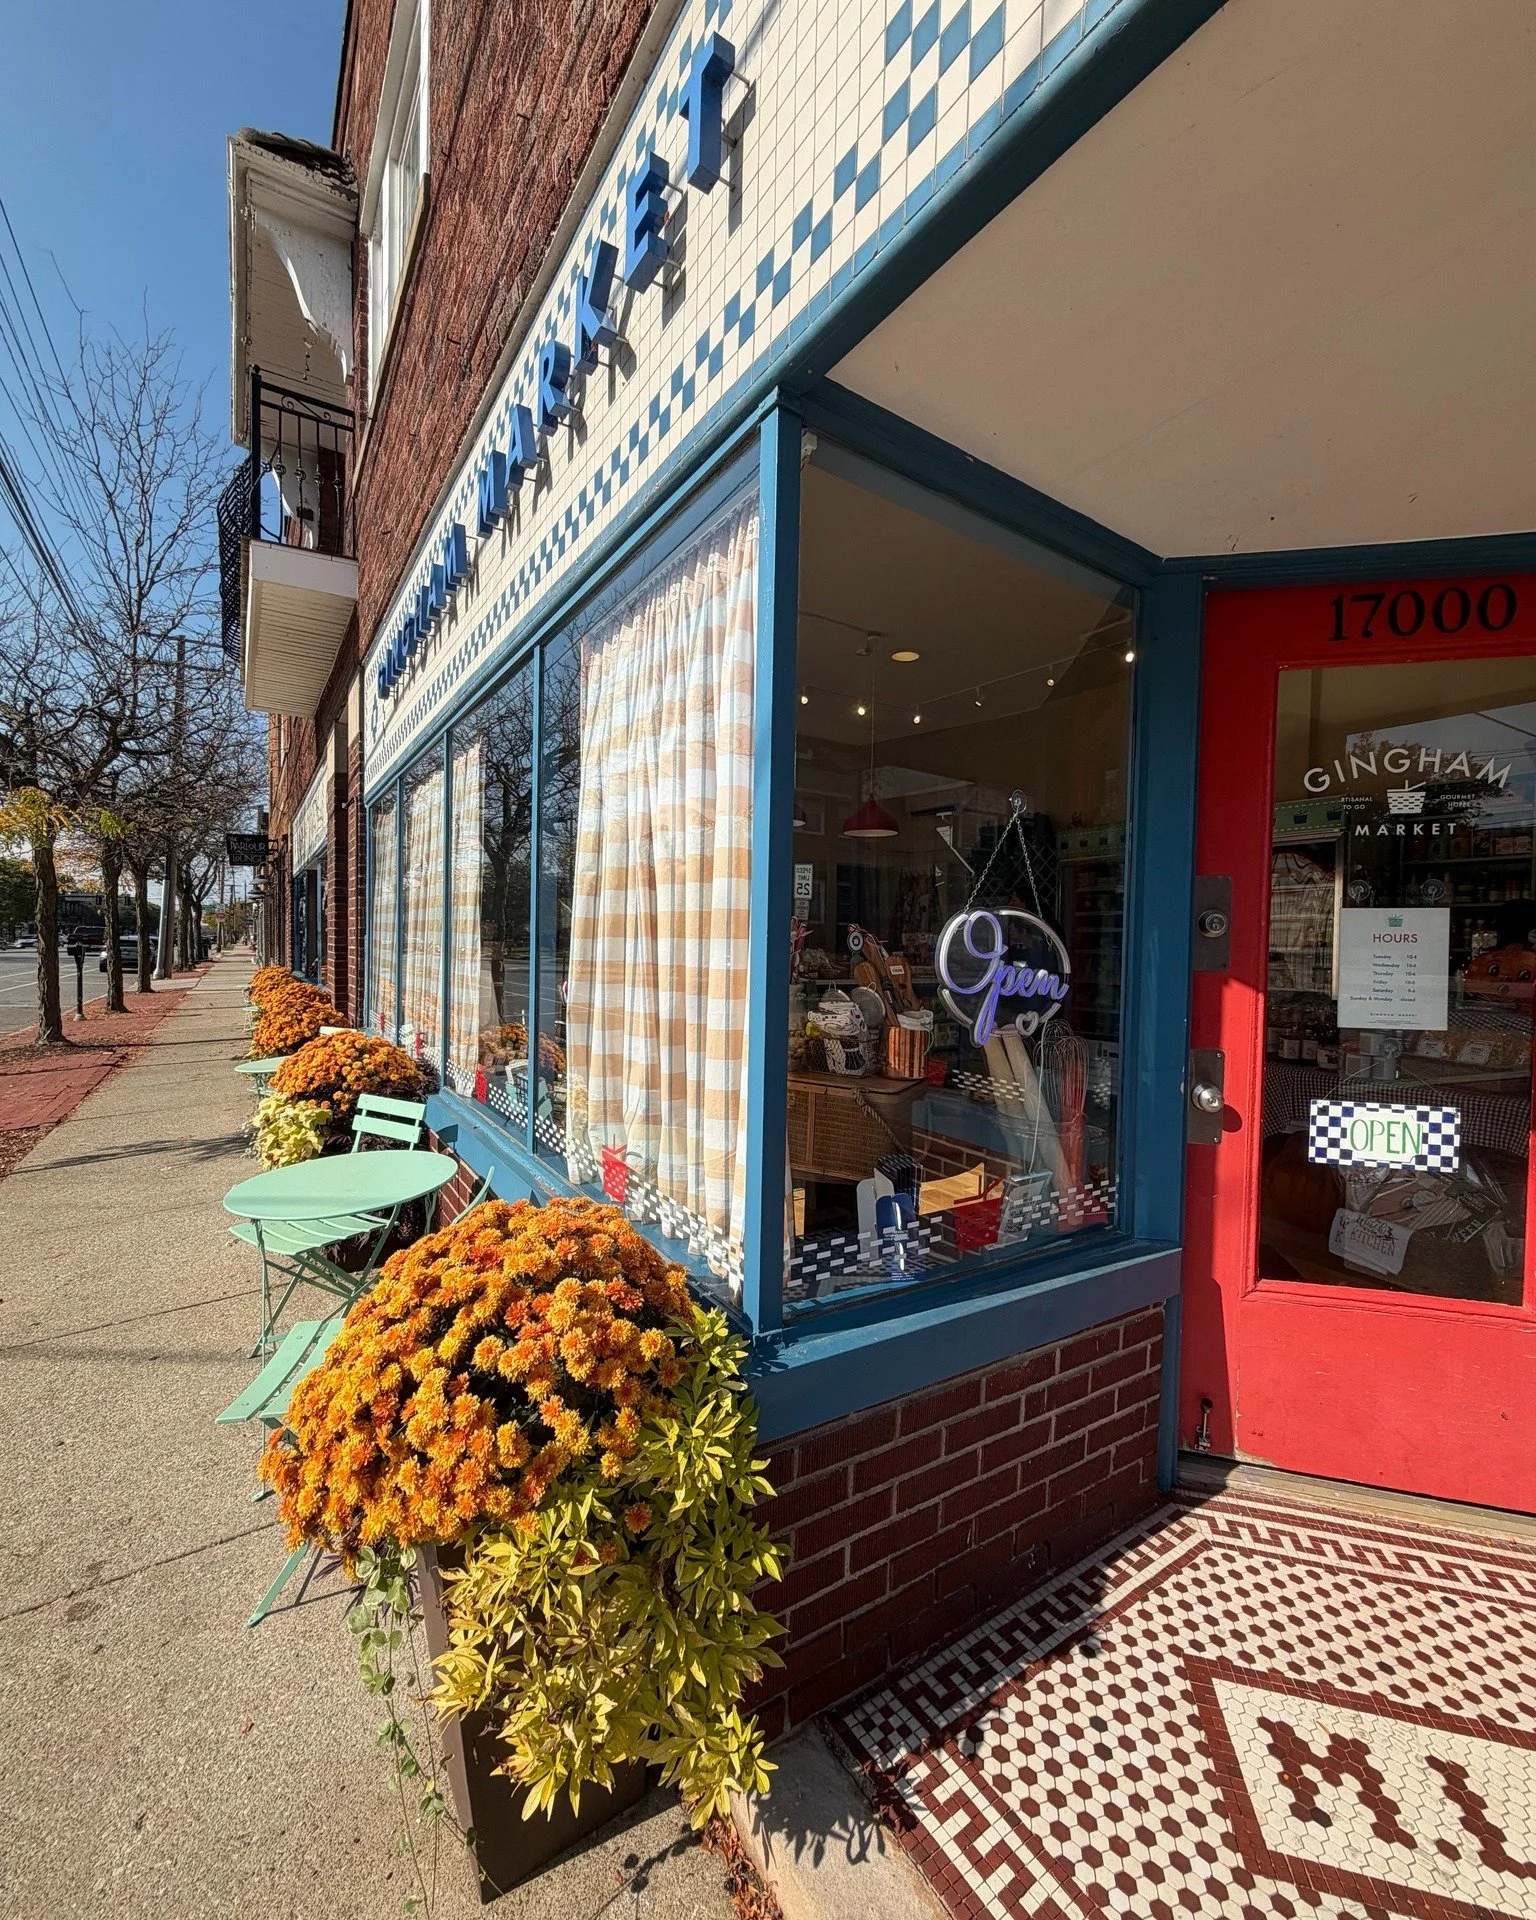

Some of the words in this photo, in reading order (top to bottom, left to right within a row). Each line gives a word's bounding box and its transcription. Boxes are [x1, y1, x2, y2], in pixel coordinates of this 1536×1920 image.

[377, 522, 469, 700] GINGHAM
[477, 31, 735, 540] MARKET
[1328, 583, 1518, 642] 17000
[1303, 747, 1512, 793] GINGHAM
[230, 841, 266, 851] PARLOUR
[1355, 823, 1457, 836] MARKET
[232, 852, 263, 863] LOUNGE
[1372, 933, 1418, 943] HOURS
[940, 910, 1070, 1046] Open
[1350, 1118, 1421, 1155] OPEN
[1349, 1227, 1395, 1257] KITCHEN
